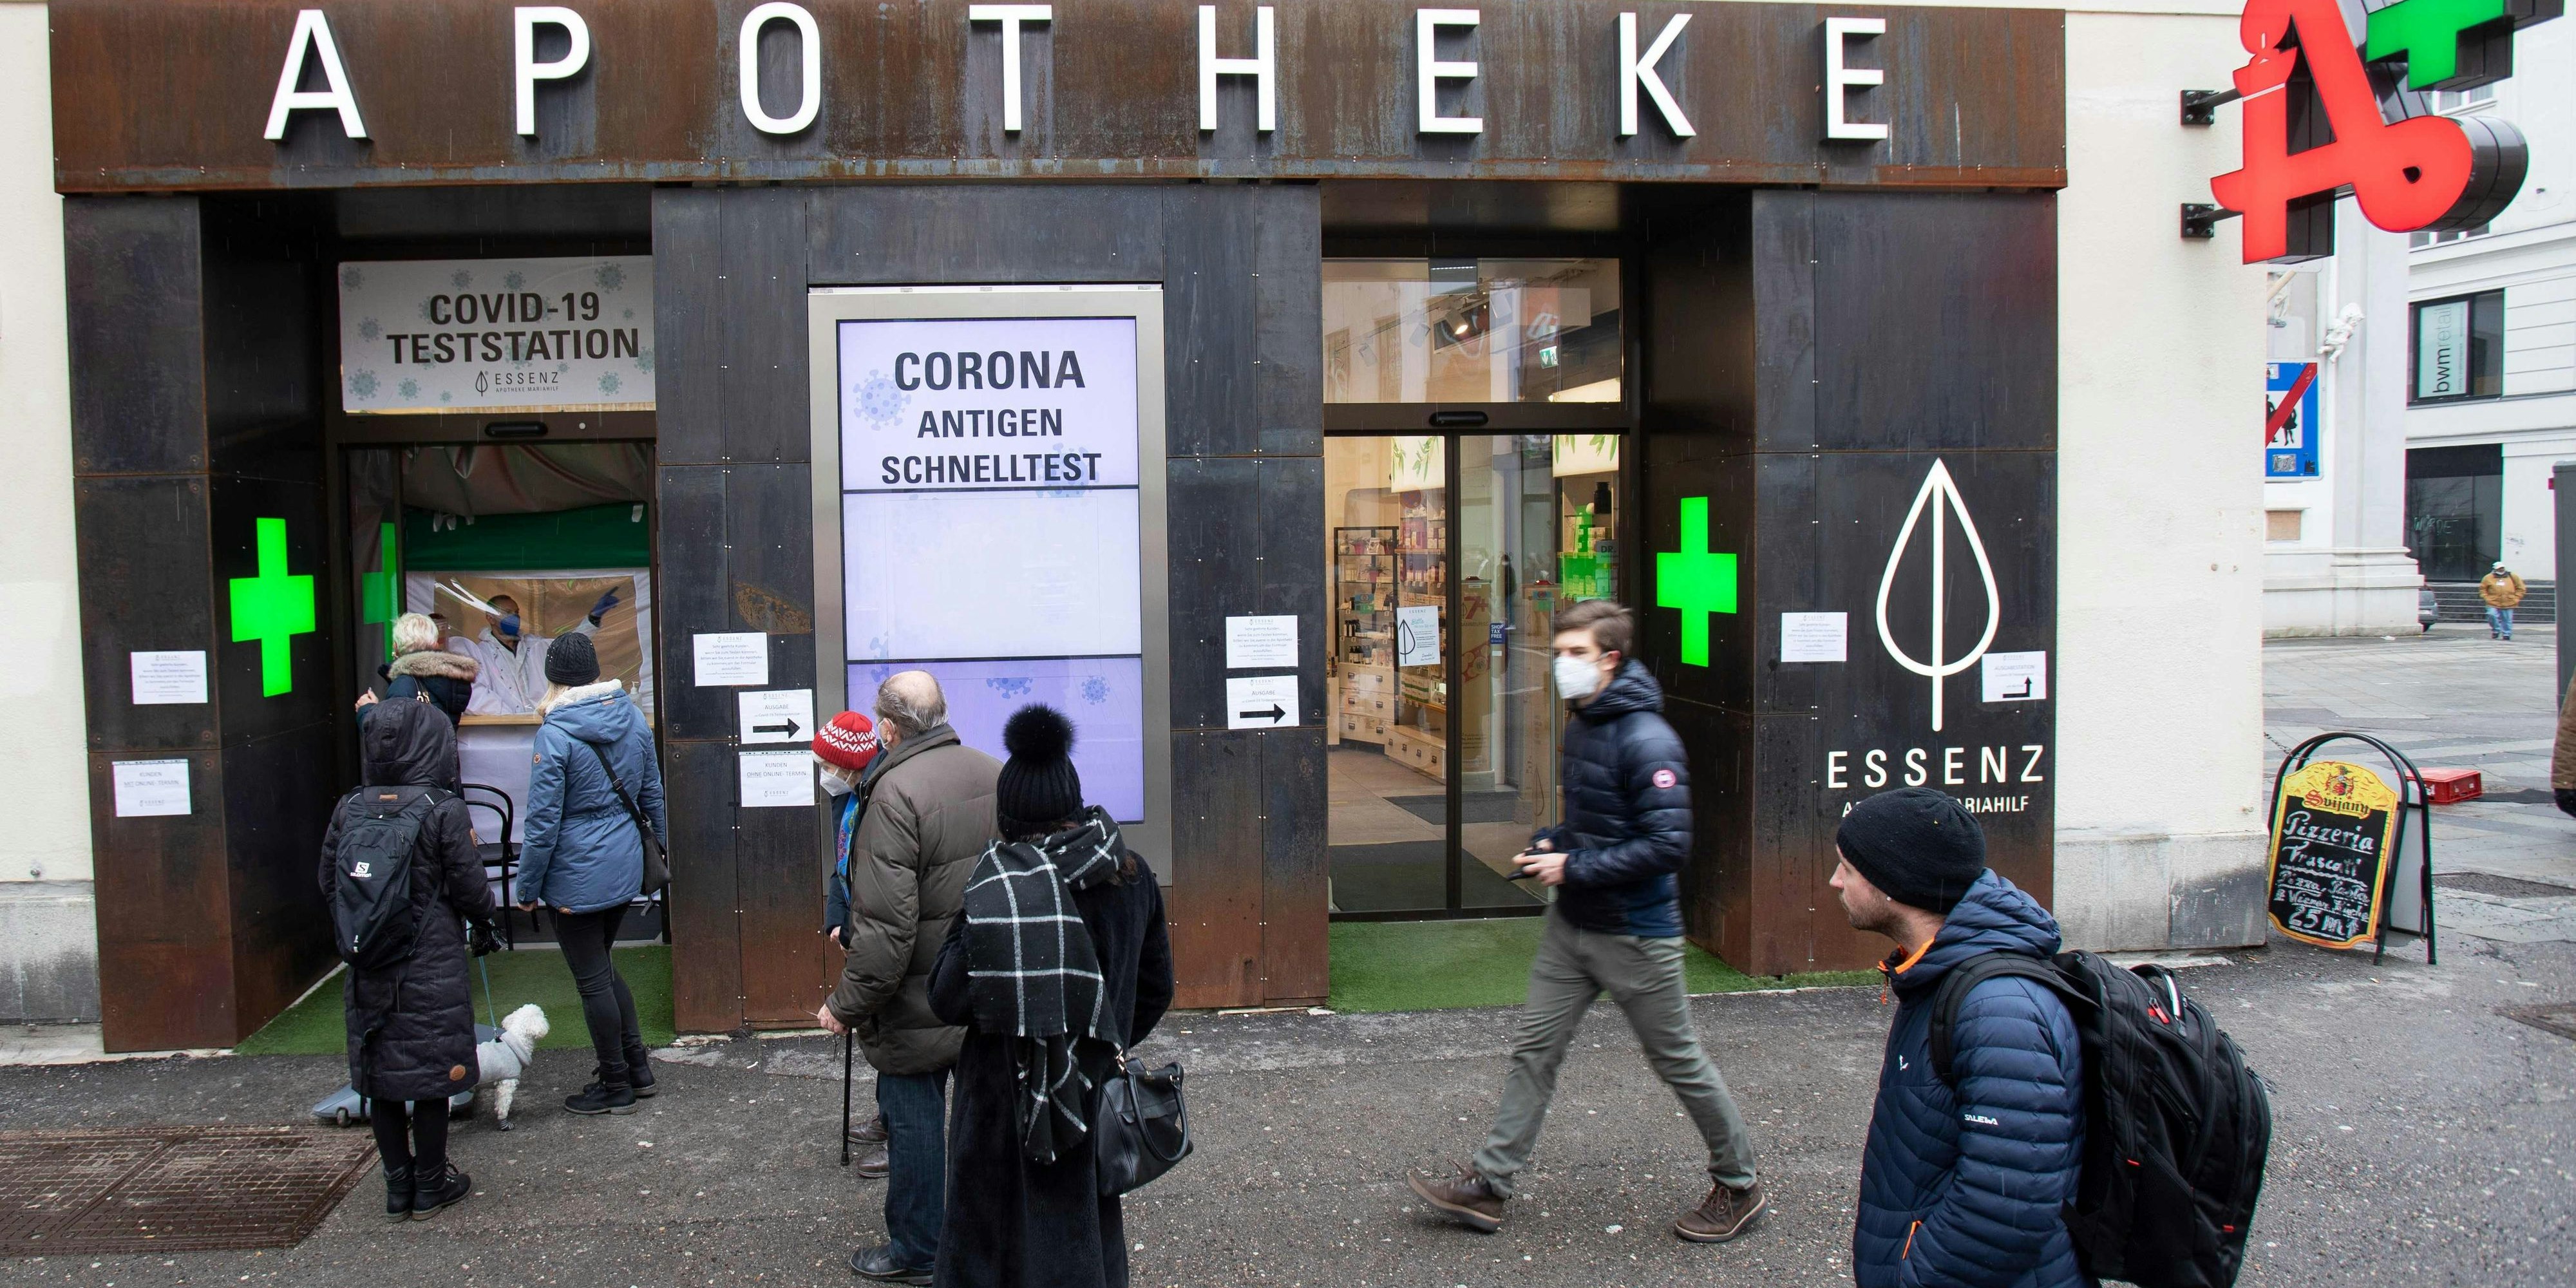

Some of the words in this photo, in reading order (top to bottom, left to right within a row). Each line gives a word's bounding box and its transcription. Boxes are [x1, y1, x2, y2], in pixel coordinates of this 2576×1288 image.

[264, 2, 1888, 142] APOTHEKE
[429, 291, 600, 325] COVID-19
[386, 328, 639, 364] TESTSTATION
[495, 372, 558, 385] ESSENZ
[895, 350, 1086, 391] CORONA
[917, 409, 1063, 438] ANTIGEN
[882, 453, 1102, 485] SCHNELLTEST
[1828, 745, 2043, 788] ESSENZ
[1957, 795, 2029, 813] RIAHILF
[2304, 790, 2370, 815] Svijany
[2282, 811, 2375, 850] Pizzeria
